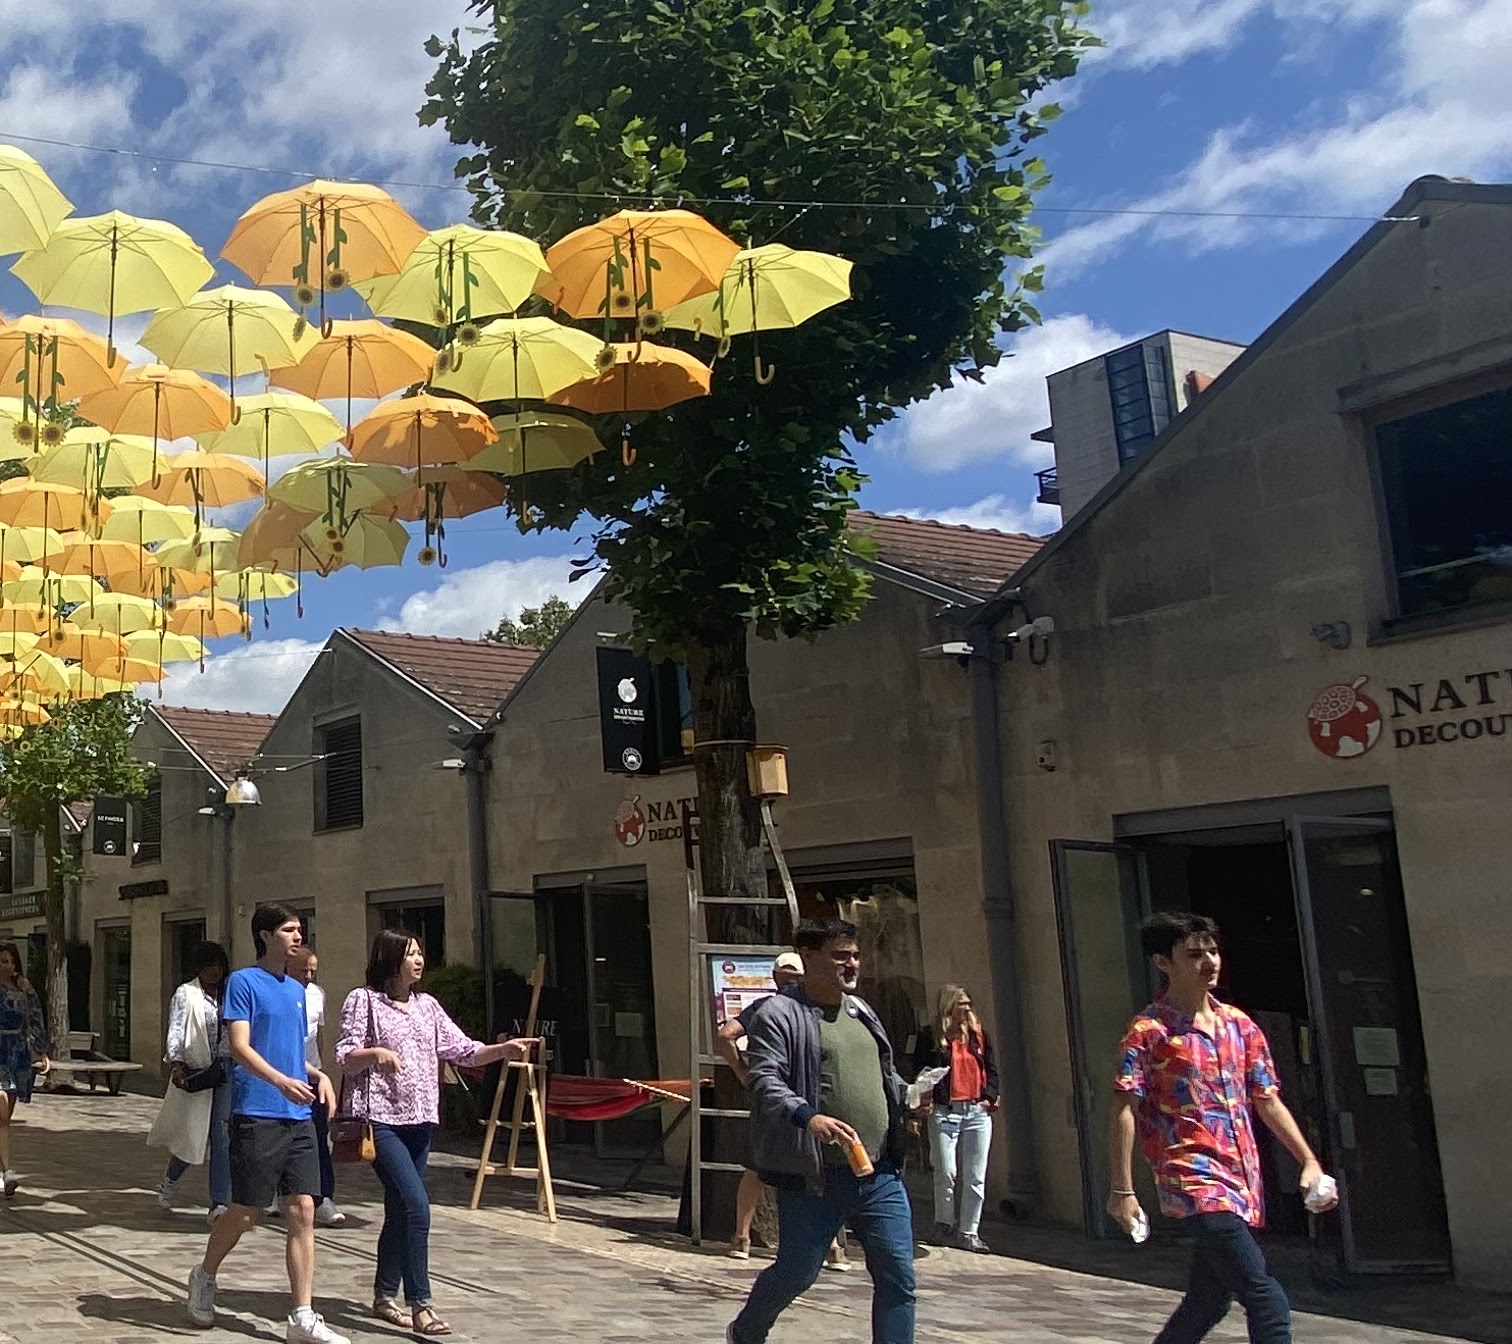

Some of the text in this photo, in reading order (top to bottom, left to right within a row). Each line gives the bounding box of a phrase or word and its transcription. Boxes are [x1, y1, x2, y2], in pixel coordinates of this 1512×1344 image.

[1386, 668, 1512, 718] NAT
[613, 707, 644, 717] NATURE
[1394, 713, 1512, 748] DECOU
